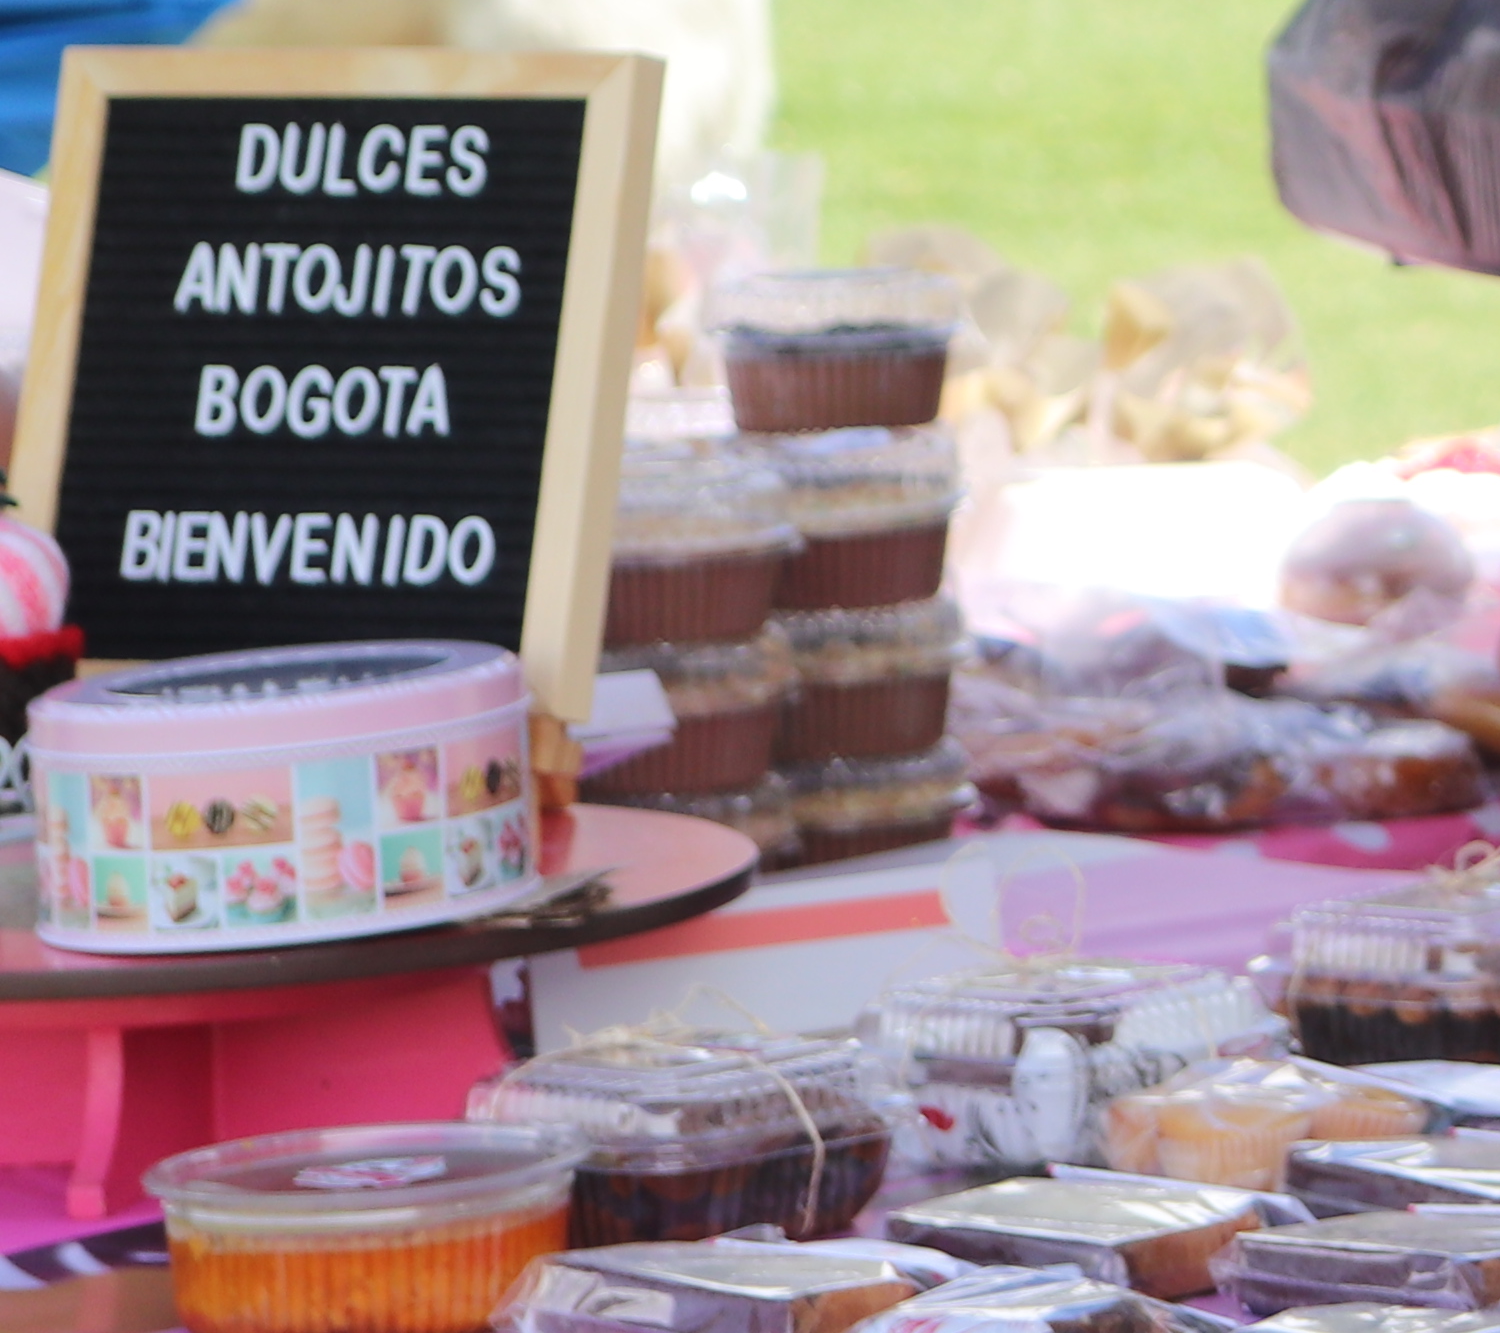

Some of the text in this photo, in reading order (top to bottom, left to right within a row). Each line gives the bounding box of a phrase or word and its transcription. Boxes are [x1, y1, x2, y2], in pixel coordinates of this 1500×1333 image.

[235, 121, 489, 197] DULCES
[174, 241, 520, 317] ANTOJITOS
[194, 363, 450, 437] BOGOTA
[119, 509, 496, 586] BIENVENIDO
